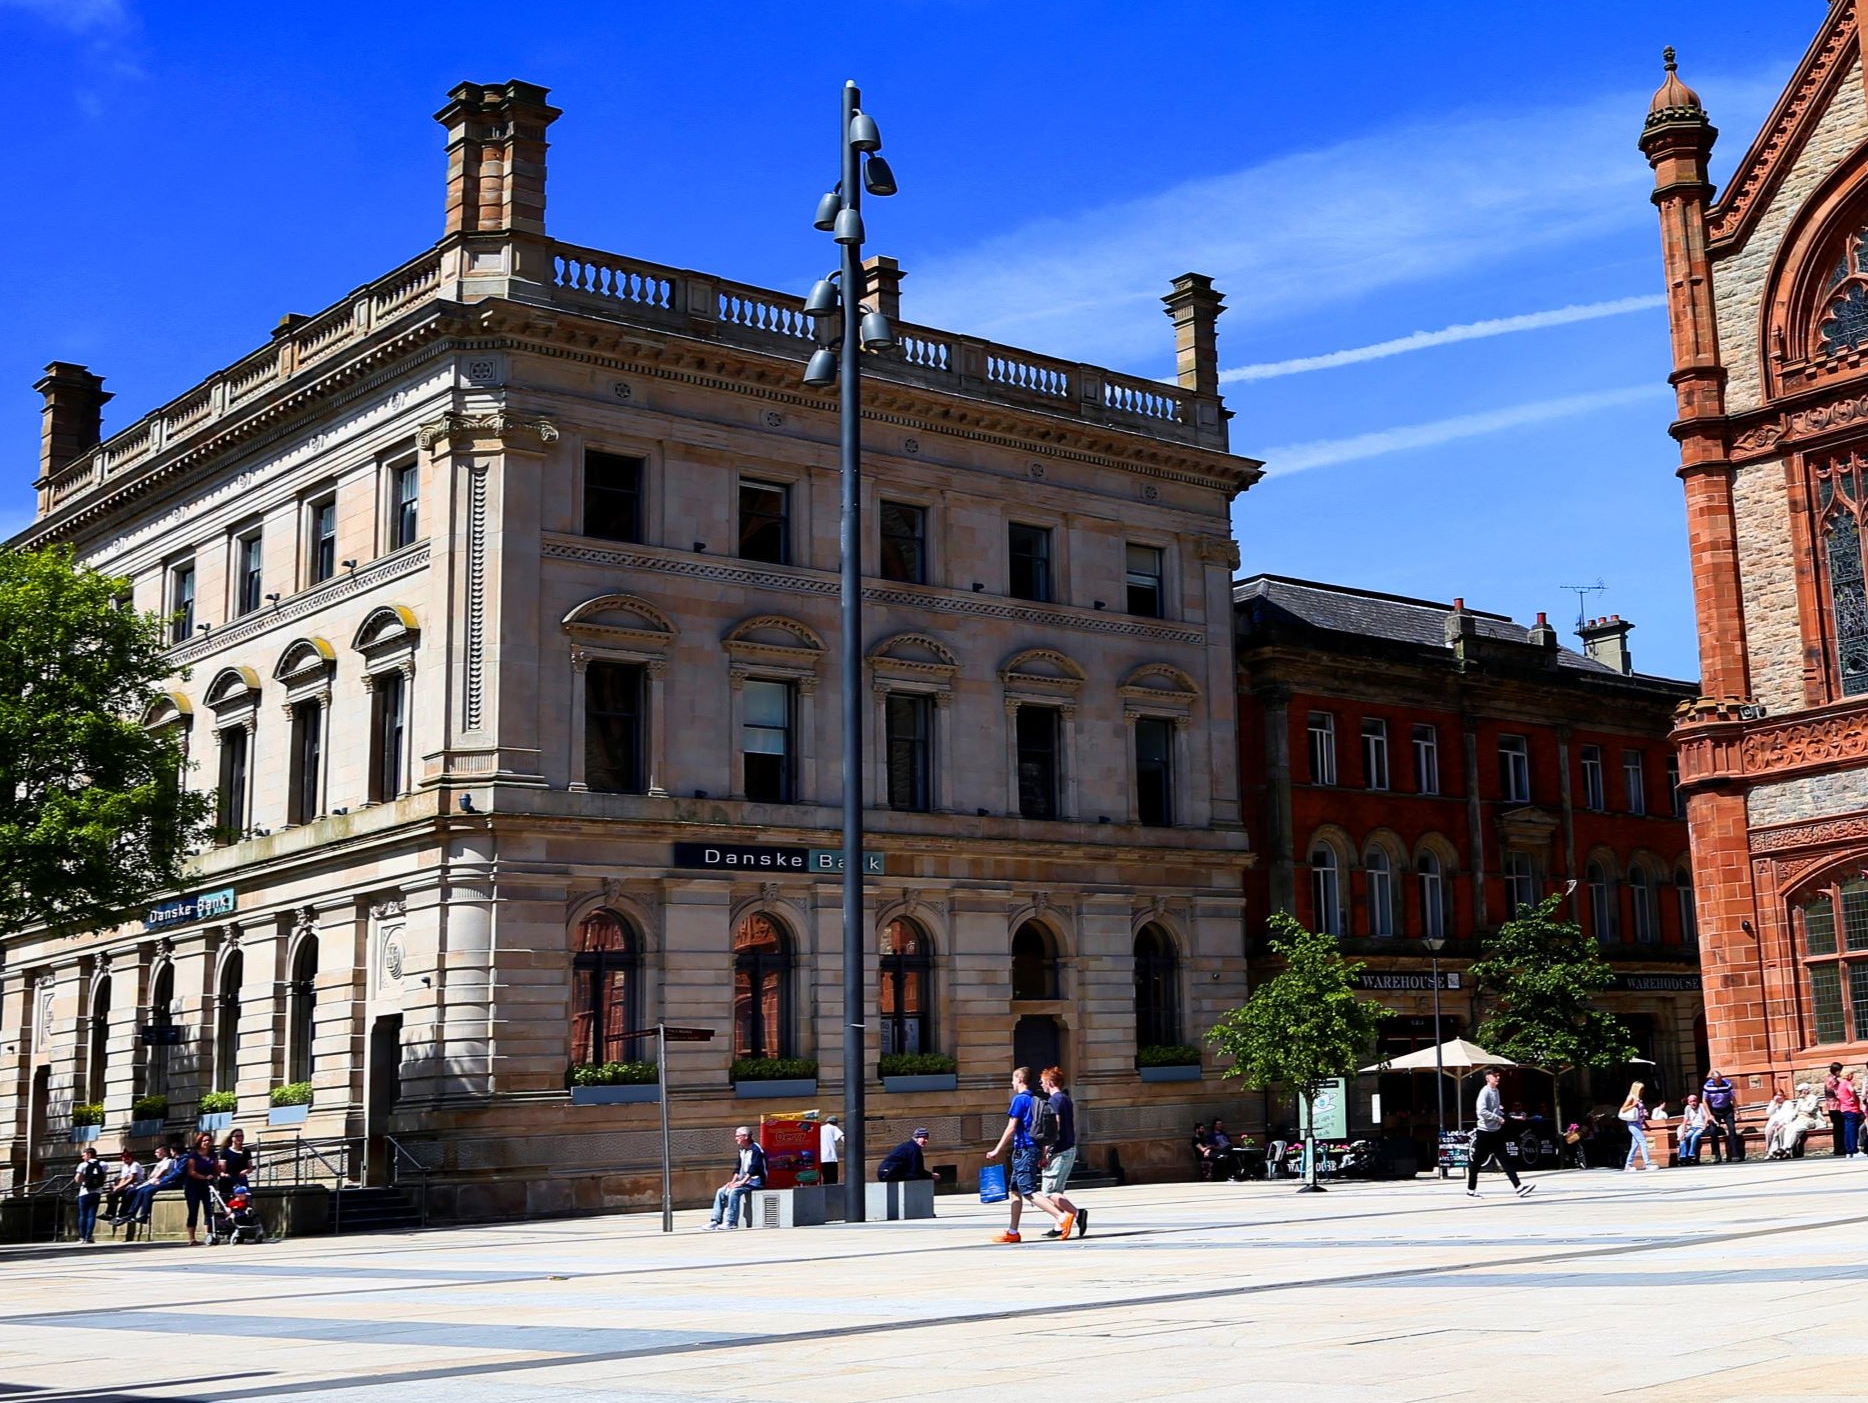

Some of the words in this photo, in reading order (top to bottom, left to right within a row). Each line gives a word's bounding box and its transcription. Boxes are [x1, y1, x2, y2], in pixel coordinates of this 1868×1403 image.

[704, 849, 802, 867] Danske
[819, 854, 880, 870] Bak
[149, 903, 191, 923] Danske
[197, 894, 229, 912] Bank
[1361, 975, 1445, 989] WAREHOUSE
